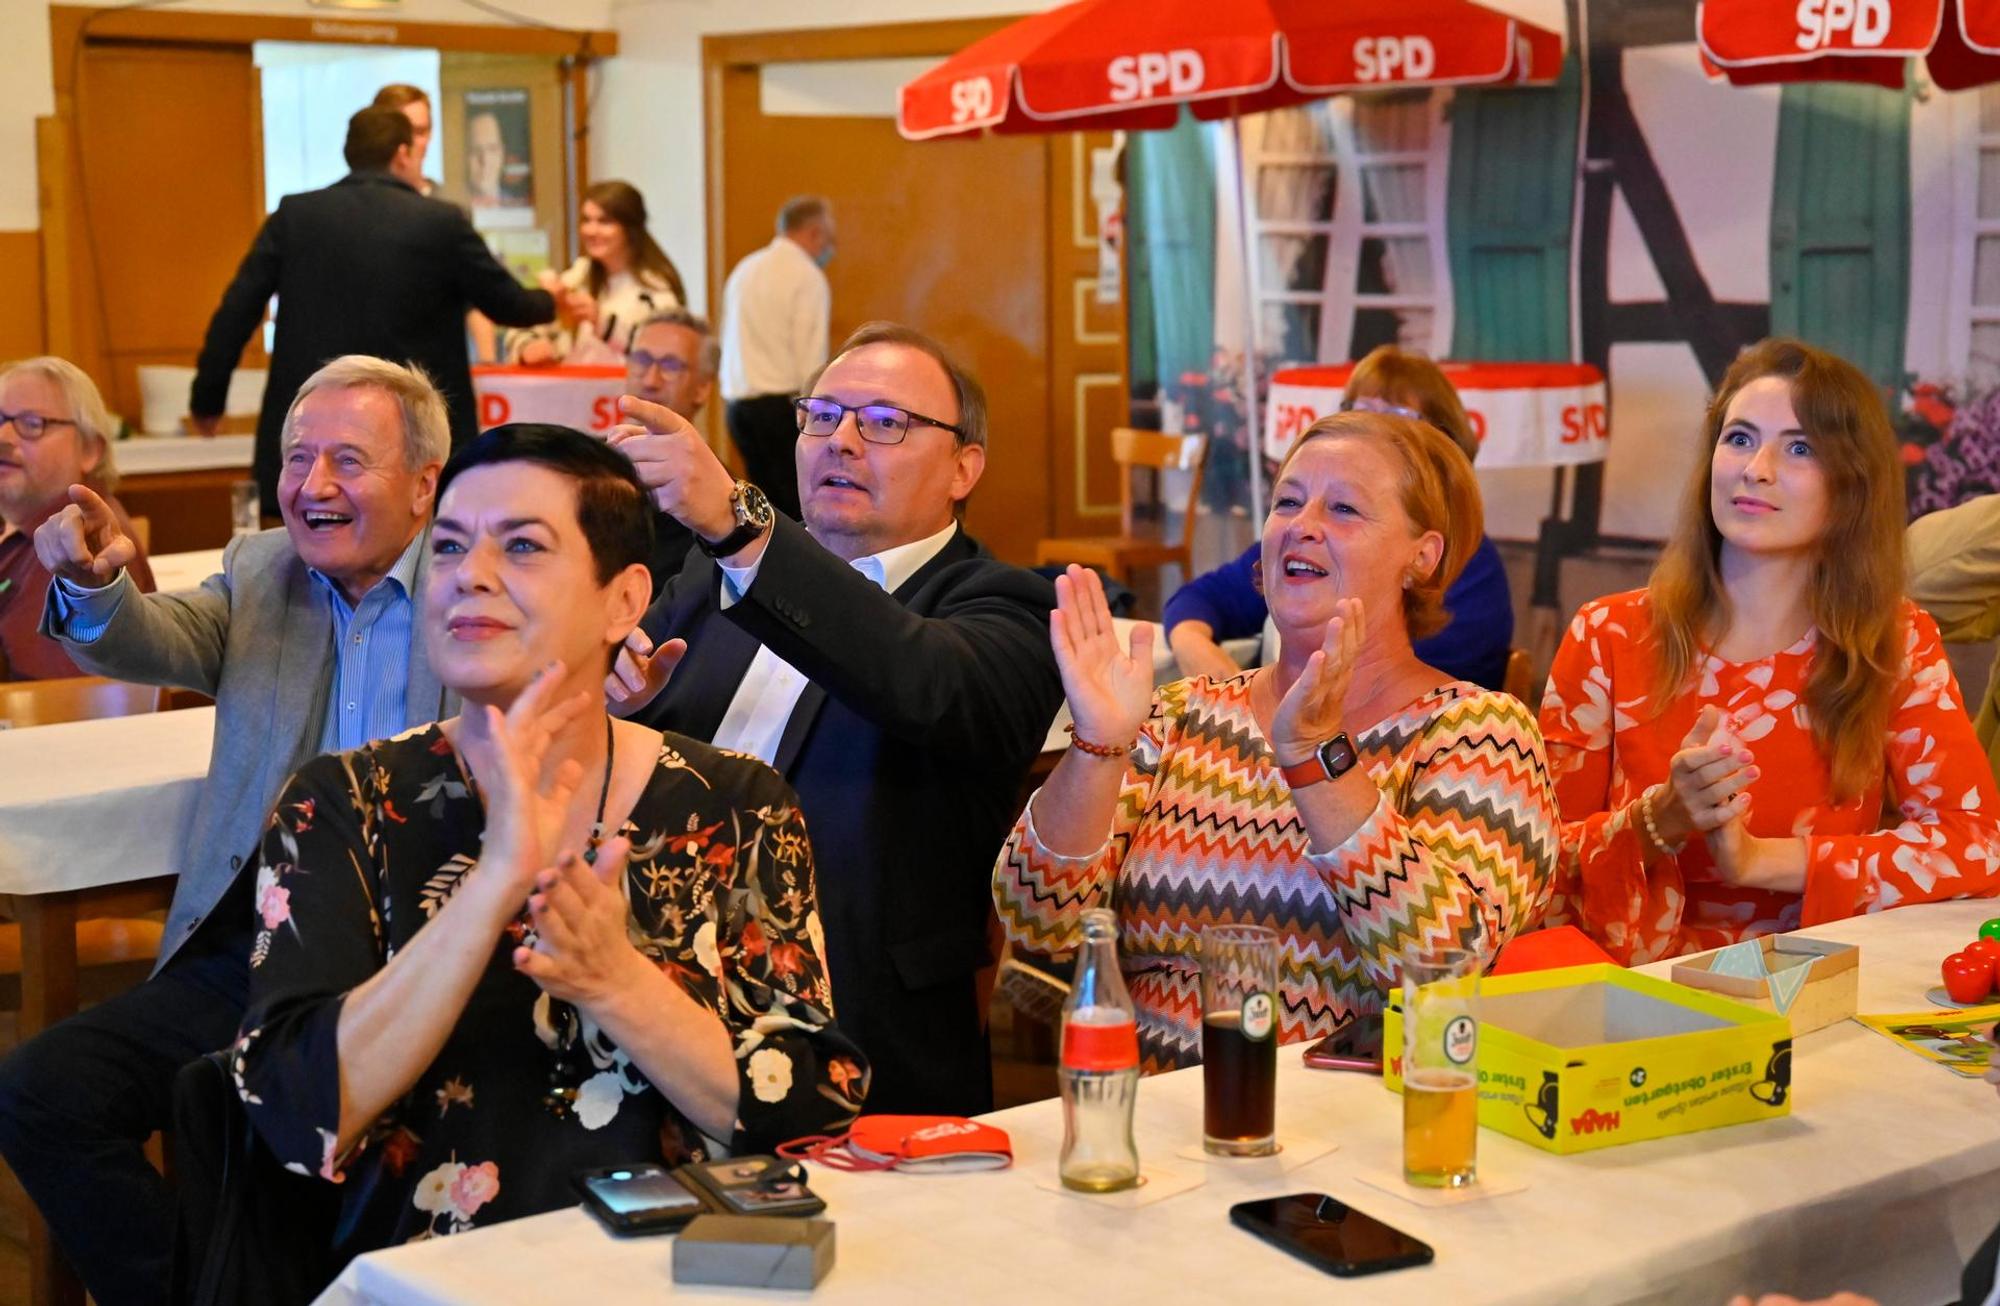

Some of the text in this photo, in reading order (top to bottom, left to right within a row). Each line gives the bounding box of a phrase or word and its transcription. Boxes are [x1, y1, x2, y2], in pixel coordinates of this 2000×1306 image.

[1795, 0, 1891, 48] SPD
[1107, 49, 1205, 102] SPD
[1353, 35, 1435, 81] SPD
[1623, 1076, 1706, 1107] Obstgarten
[1710, 1062, 1753, 1083] Erster
[1570, 1108, 1620, 1135] HABA
